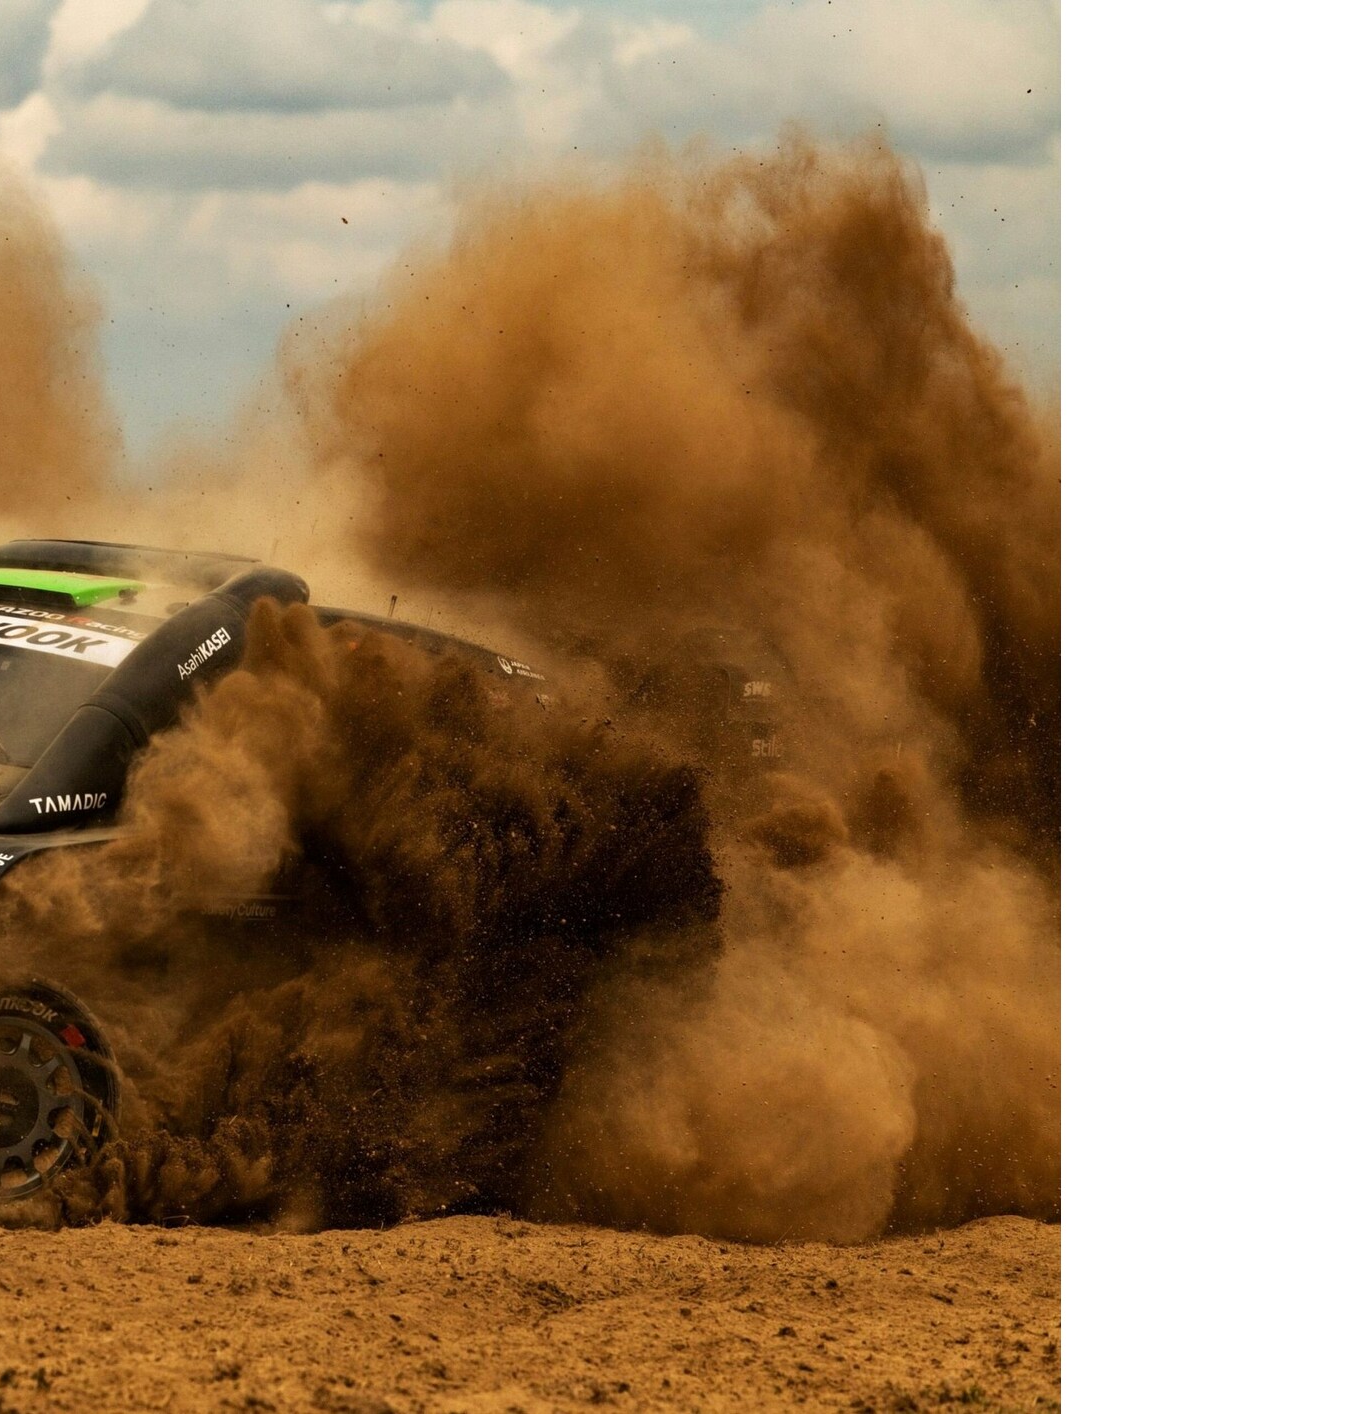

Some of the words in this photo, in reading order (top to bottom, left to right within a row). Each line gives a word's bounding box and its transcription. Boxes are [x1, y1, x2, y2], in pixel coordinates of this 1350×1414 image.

[66, 616, 148, 640] Racing
[177, 626, 232, 680] AsahiKASEI
[29, 792, 108, 814] TAMADIC
